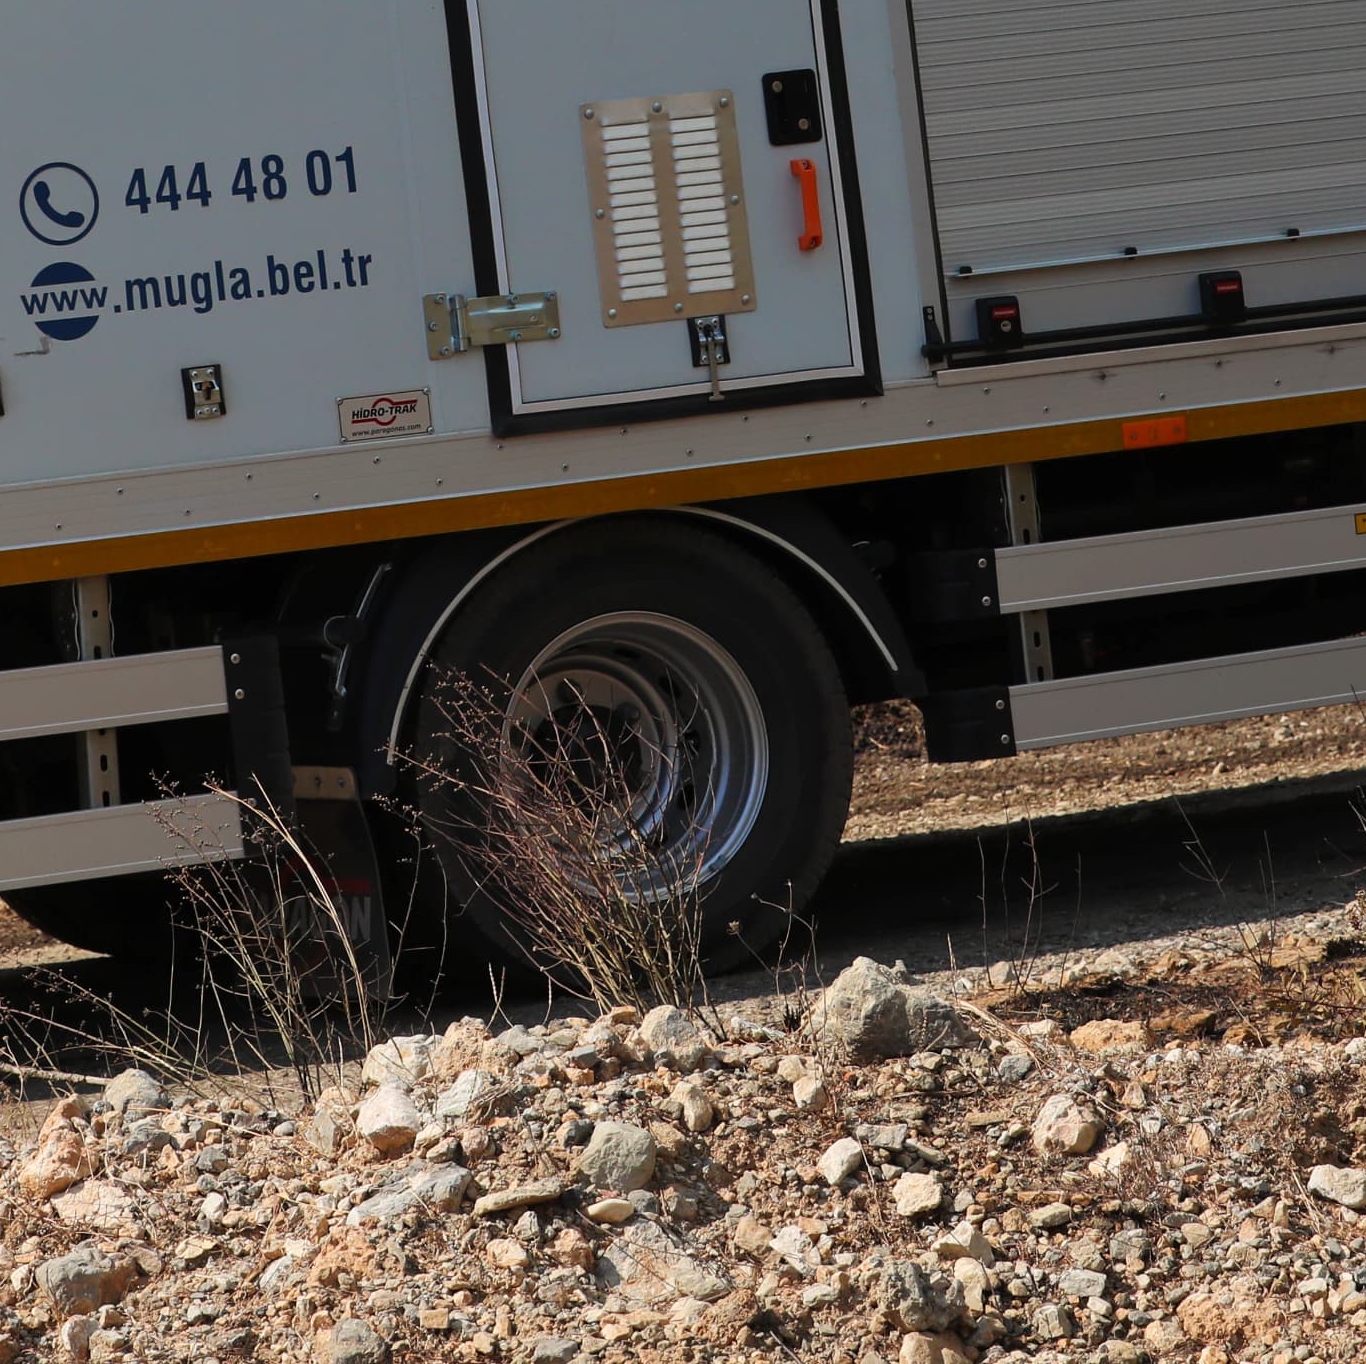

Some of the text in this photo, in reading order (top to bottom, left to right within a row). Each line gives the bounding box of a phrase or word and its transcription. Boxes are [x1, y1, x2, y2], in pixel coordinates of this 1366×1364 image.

[125, 146, 359, 214] 444 48 01
[20, 248, 373, 314] www.mugla.bel.tr
[352, 404, 417, 419] HİDRO-TRAK
